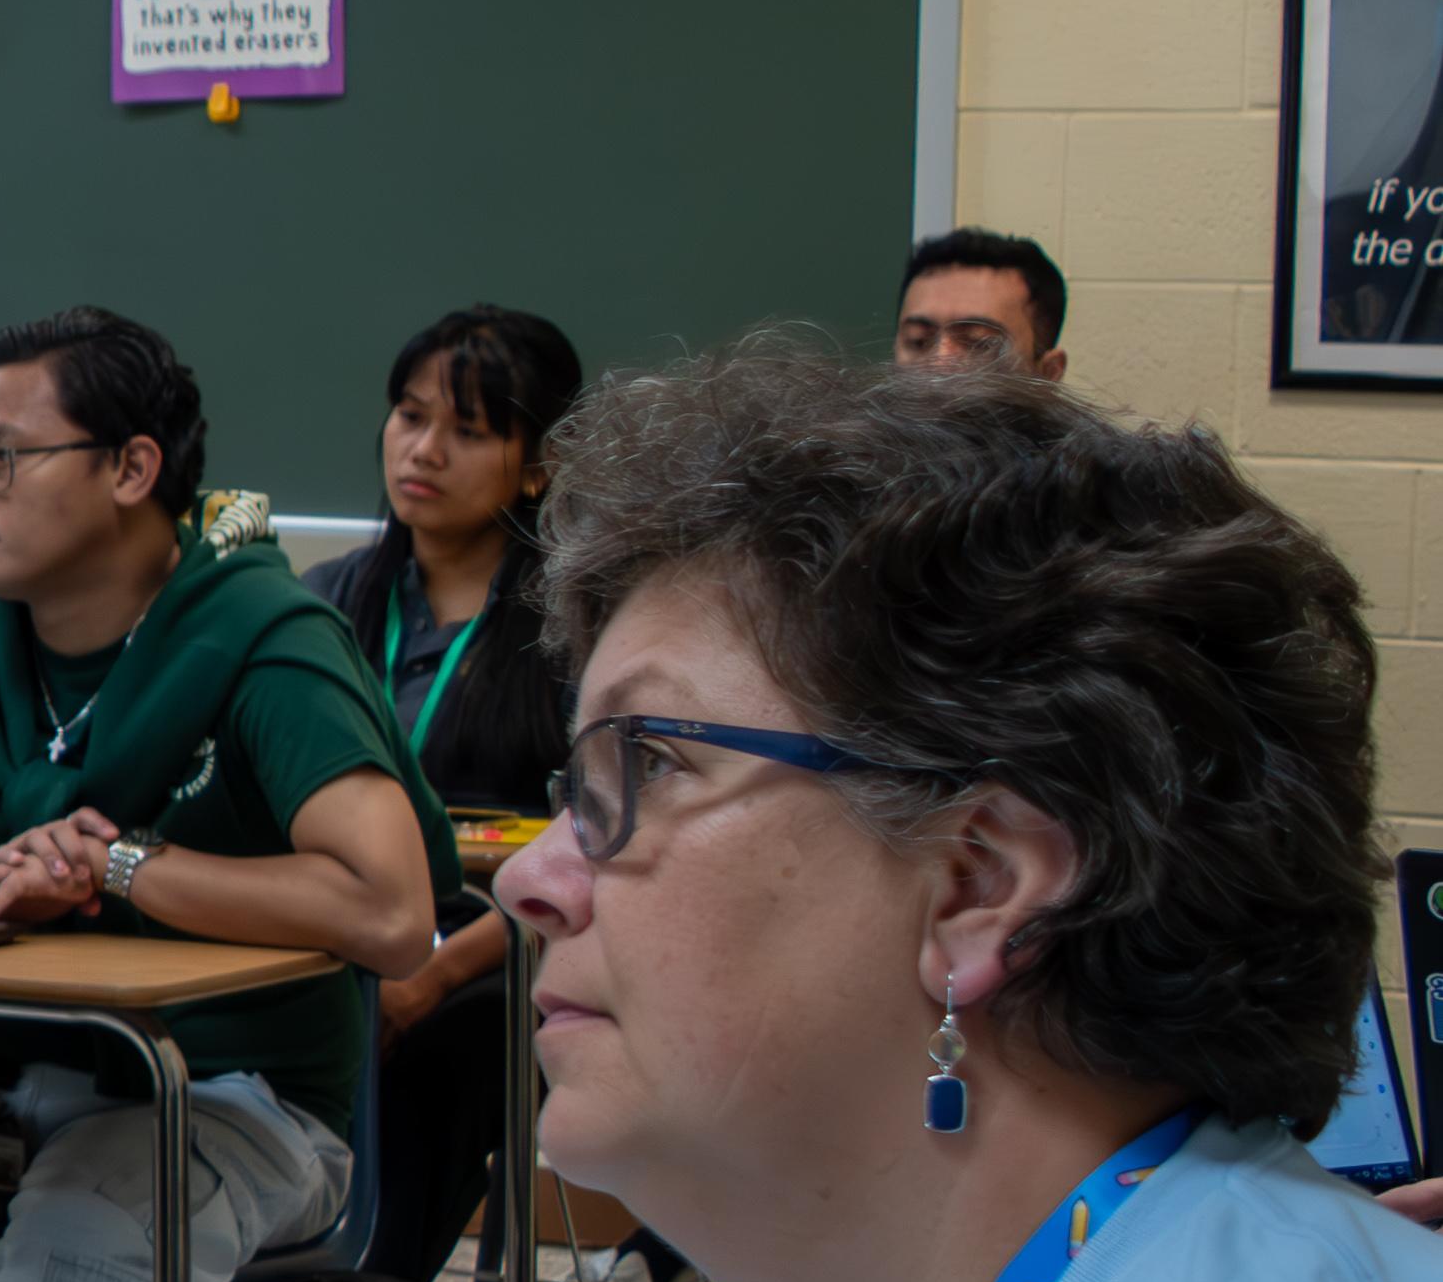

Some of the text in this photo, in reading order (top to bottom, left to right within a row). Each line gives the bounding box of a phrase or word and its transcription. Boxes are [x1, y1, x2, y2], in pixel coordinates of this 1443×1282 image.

[141, 4, 199, 29] that's
[209, 2, 253, 31] why
[133, 28, 318, 55] invented erasers
[1367, 177, 1400, 213] if
[1352, 229, 1413, 266] the
